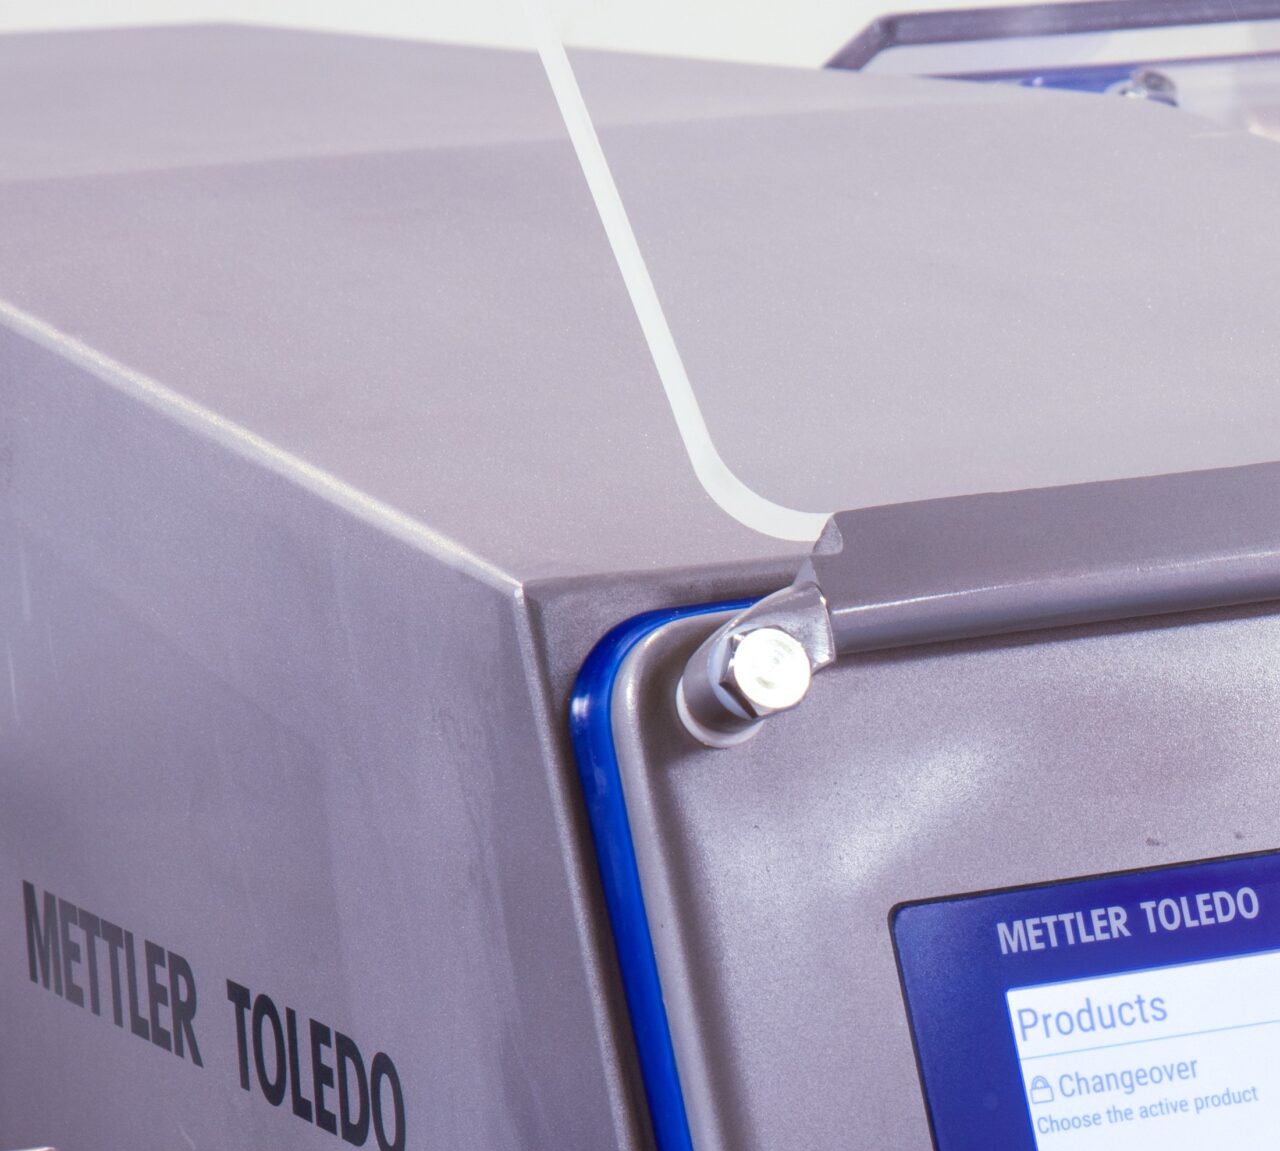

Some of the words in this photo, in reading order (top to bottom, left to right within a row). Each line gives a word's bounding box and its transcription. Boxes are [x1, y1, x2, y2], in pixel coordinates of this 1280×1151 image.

[996, 907, 1131, 955] METTLER
[1140, 886, 1260, 934] TOLEDO
[22, 879, 204, 1068] METTLER
[1017, 993, 1168, 1042] Products
[1058, 1059, 1199, 1098] Changeover
[1037, 1111, 1103, 1136] Choose
[1106, 1104, 1135, 1125] the
[1139, 1096, 1190, 1119] active
[1194, 1085, 1260, 1114] product
